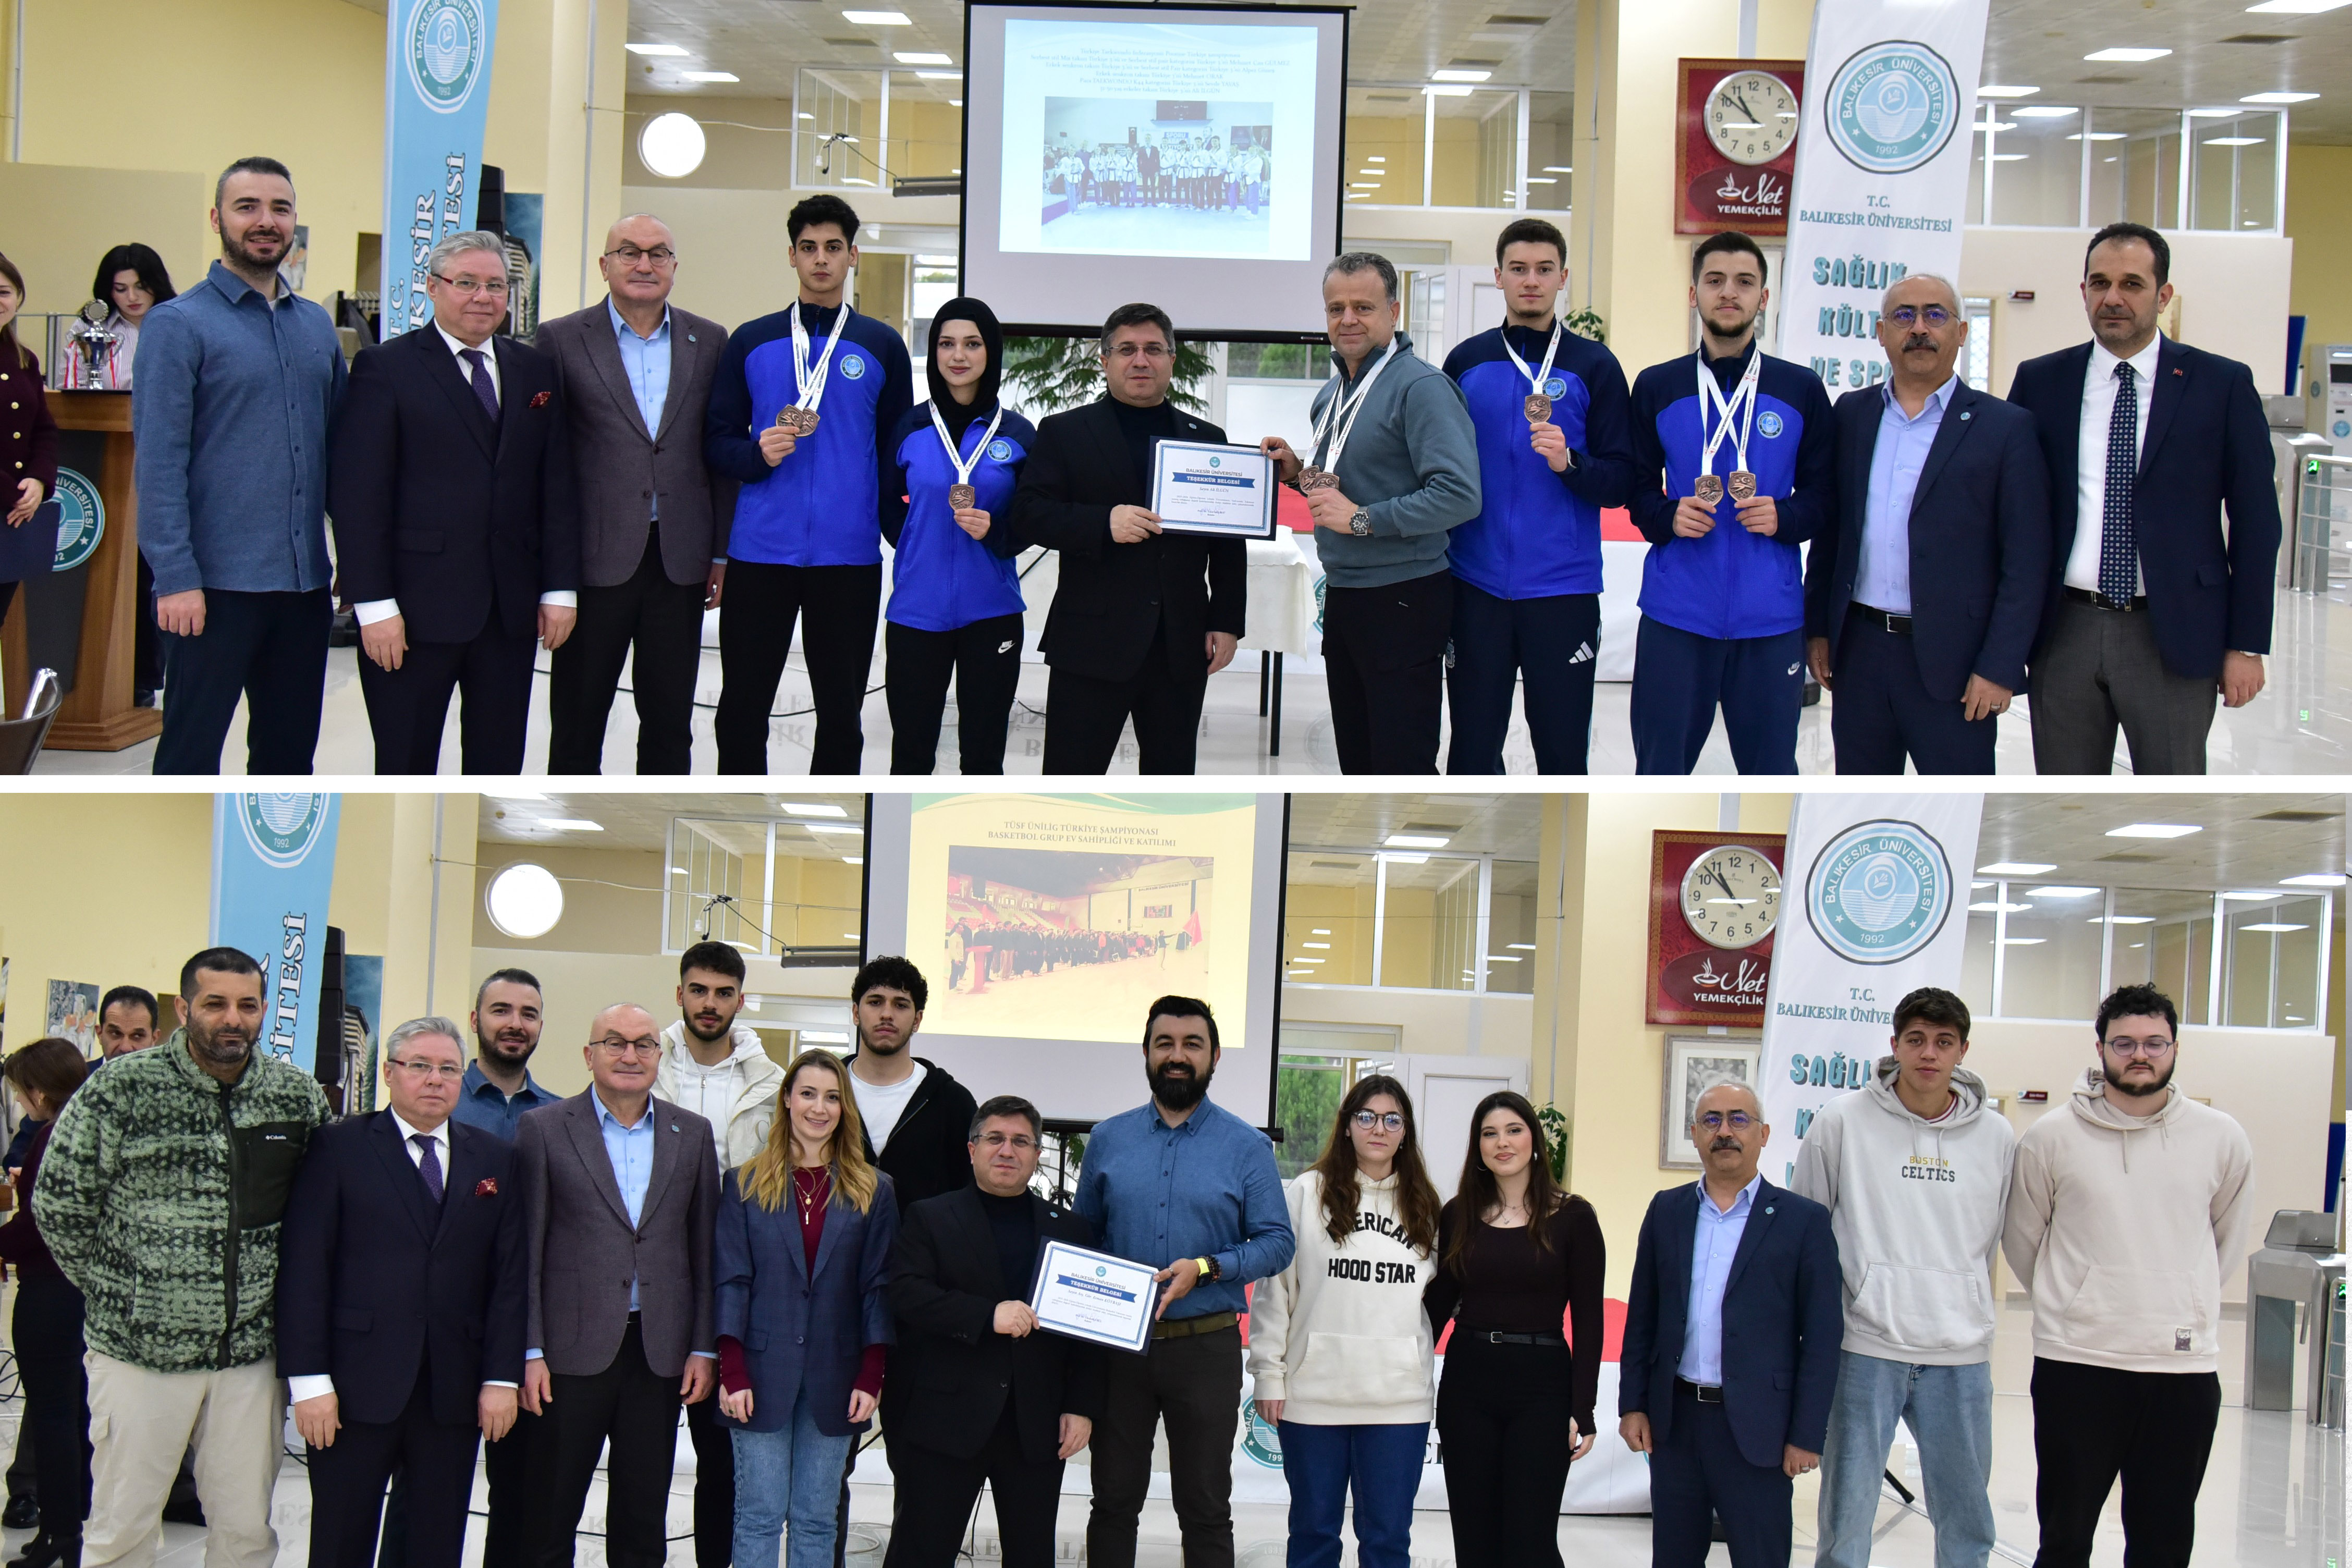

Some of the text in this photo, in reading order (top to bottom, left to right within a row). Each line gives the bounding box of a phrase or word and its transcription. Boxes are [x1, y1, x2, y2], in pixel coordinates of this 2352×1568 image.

[1732, 85, 1741, 96] 11
[1747, 81, 1759, 91] 12
[1767, 87, 1771, 96] 1
[1843, 57, 1943, 124] BALIKESİR ÜNİVERSİTESİ
[1721, 96, 1732, 107] 10
[1778, 99, 1785, 108] 2
[1716, 112, 1722, 122] 9
[1721, 128, 1728, 139] 8
[1775, 130, 1782, 139] 4
[1732, 140, 1738, 150] 7
[1747, 144, 1754, 154] 6
[1763, 141, 1770, 151] 5
[1876, 144, 1898, 155] 1992
[1742, 173, 1783, 204] Net
[1867, 195, 1890, 207] T.C.
[1718, 204, 1782, 217] YEMEKÇİLİK
[1799, 210, 1952, 232] BALIKESİR ÜNİVERSİTESİ
[409, 190, 435, 330] KESİR
[1818, 303, 1881, 339] KÜLT
[56, 476, 94, 529] NİVERSİTESİ
[1316, 583, 1327, 610] BALIK
[1005, 820, 1158, 835] TÜSF ÜNİLİG TÜRKİYE ŞAMPİYONASI
[274, 837, 289, 848] 1992
[988, 831, 1038, 840] BASKETBOL
[1040, 834, 1064, 842] GRUP
[1078, 835, 1121, 844] SAHİPLİĞİ
[1137, 838, 1176, 847] KATILIMI
[1711, 861, 1721, 872] 11
[1728, 857, 1741, 867] 12
[1749, 863, 1754, 873] 1
[1698, 874, 1711, 885] 10
[1825, 839, 1933, 911] BALIKESİR ÜNİVERSİTESİ
[1761, 876, 1769, 887] 2
[1693, 890, 1700, 901] 9
[1765, 893, 1772, 904] 3
[1698, 908, 1706, 919] 8
[1758, 911, 1766, 921] 4
[1710, 922, 1718, 932] 7
[1728, 926, 1735, 937] 6
[1745, 923, 1752, 934] 5
[1860, 934, 1884, 944] 1992
[1720, 959, 1766, 993] Net
[1693, 993, 1764, 1006] YEMEKÇİLİK
[1850, 988, 1875, 1001] T.C.
[1777, 1002, 1847, 1021] BALIKESİR
[1790, 1051, 1871, 1089] SAĞLI
[1909, 1156, 1948, 1167] BOSTON
[1902, 1166, 1955, 1182] CELTICS
[1328, 1258, 1416, 1283] HOOD STAR
[1071, 1272, 1126, 1290] BALIKESİR ÜNİVERSİTESİ
[1071, 1280, 1122, 1297] TEŞEKKÜR BELGESİ
[1245, 1407, 1256, 1432] BALIK
[1268, 1453, 1283, 1462] 199
